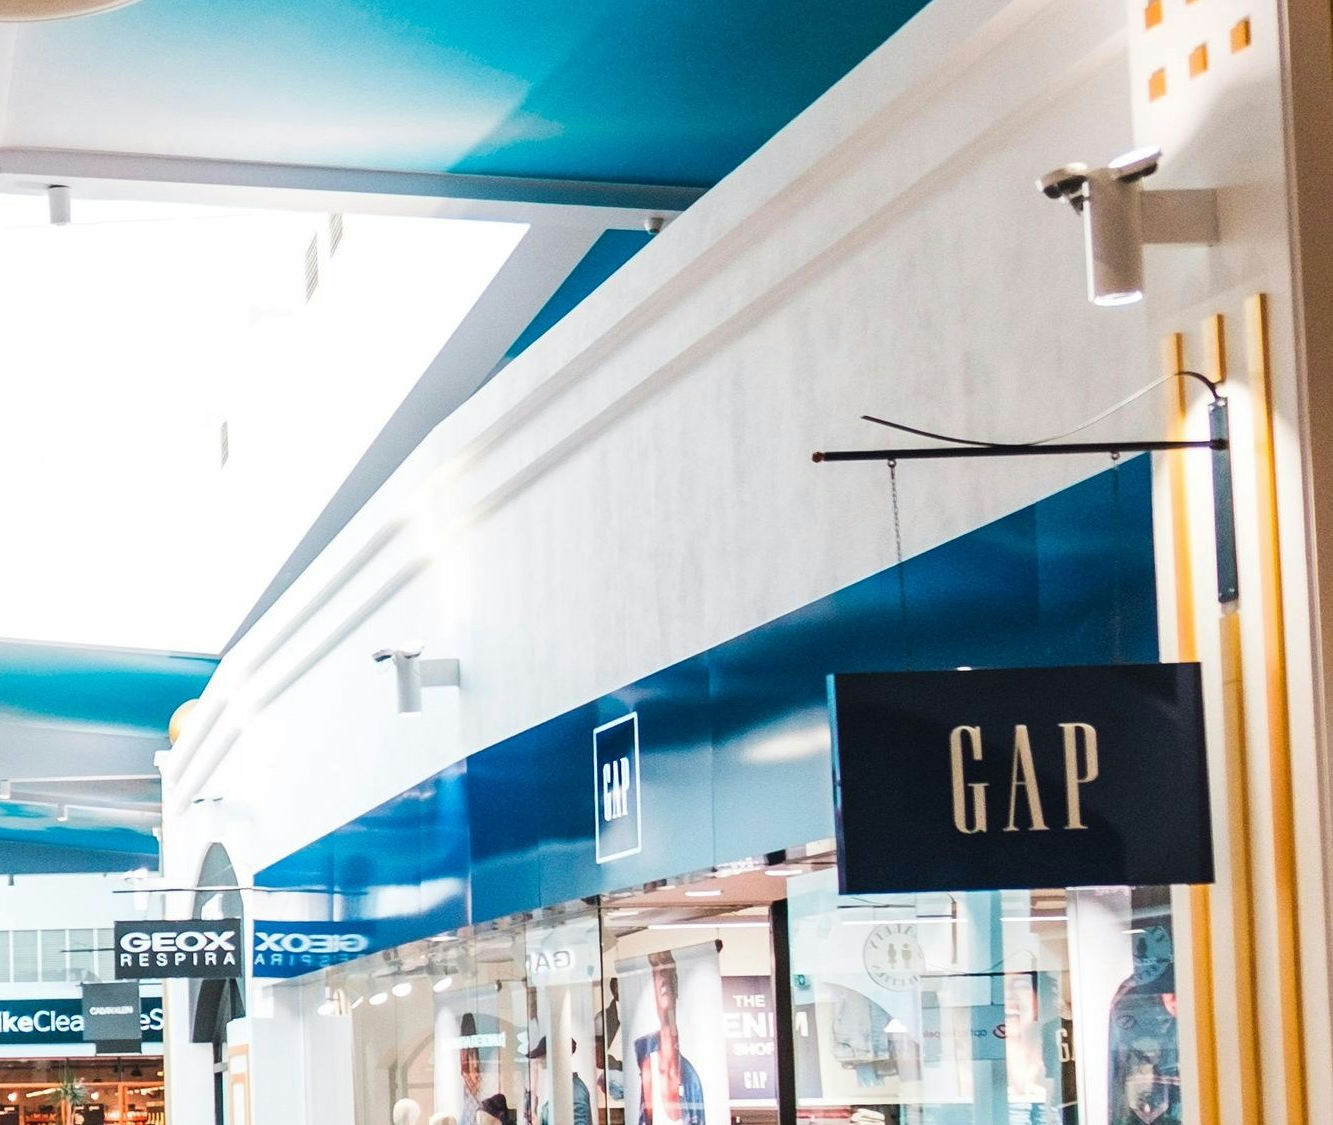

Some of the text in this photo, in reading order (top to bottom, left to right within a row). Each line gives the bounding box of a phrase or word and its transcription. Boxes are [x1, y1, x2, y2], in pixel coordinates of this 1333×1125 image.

[950, 722, 1099, 834] GAP
[603, 756, 631, 821] GAP
[120, 931, 235, 952] GEOX
[120, 953, 235, 967] RESPIRA
[733, 994, 766, 1008] THE
[744, 1071, 767, 1089] GAP
